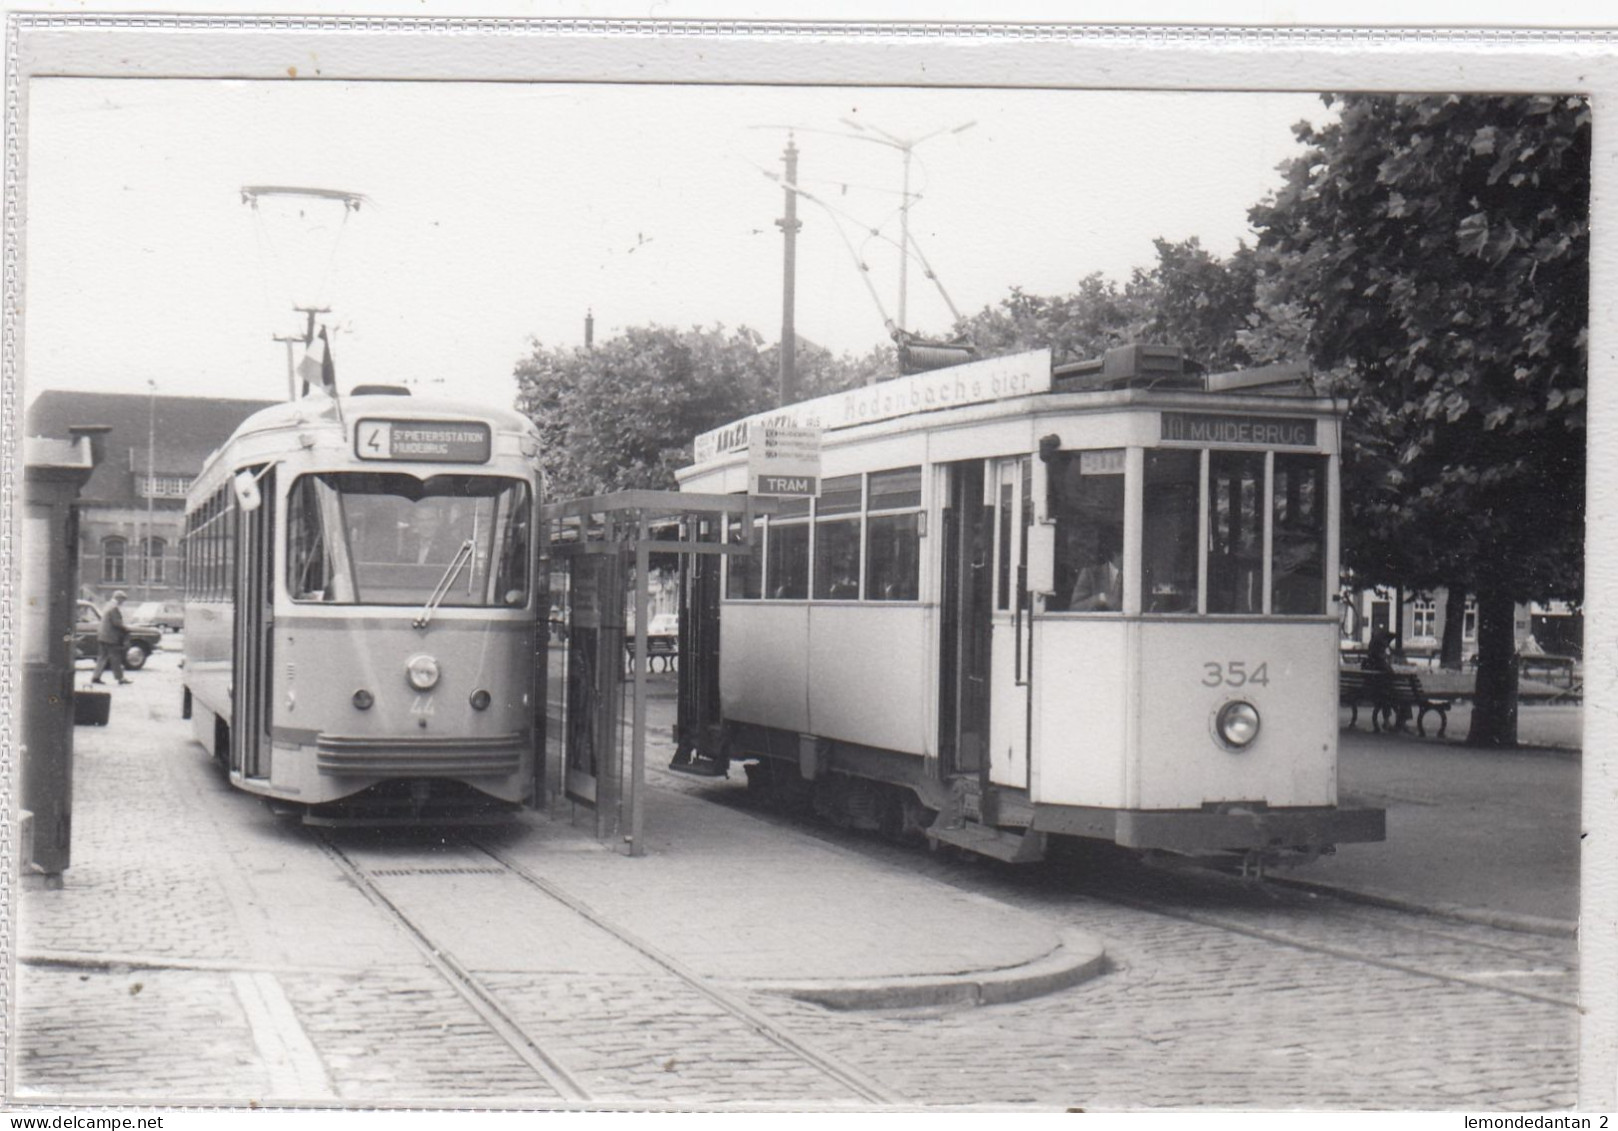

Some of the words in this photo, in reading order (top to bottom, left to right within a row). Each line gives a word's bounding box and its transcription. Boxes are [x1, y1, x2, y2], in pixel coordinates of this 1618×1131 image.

[991, 370, 1031, 395] bier
[367, 429, 380, 451] 4
[1190, 422, 1306, 443] MUIDEBRUG
[766, 478, 808, 492] TRAM
[1201, 661, 1270, 687] 354
[410, 695, 435, 715] 44
